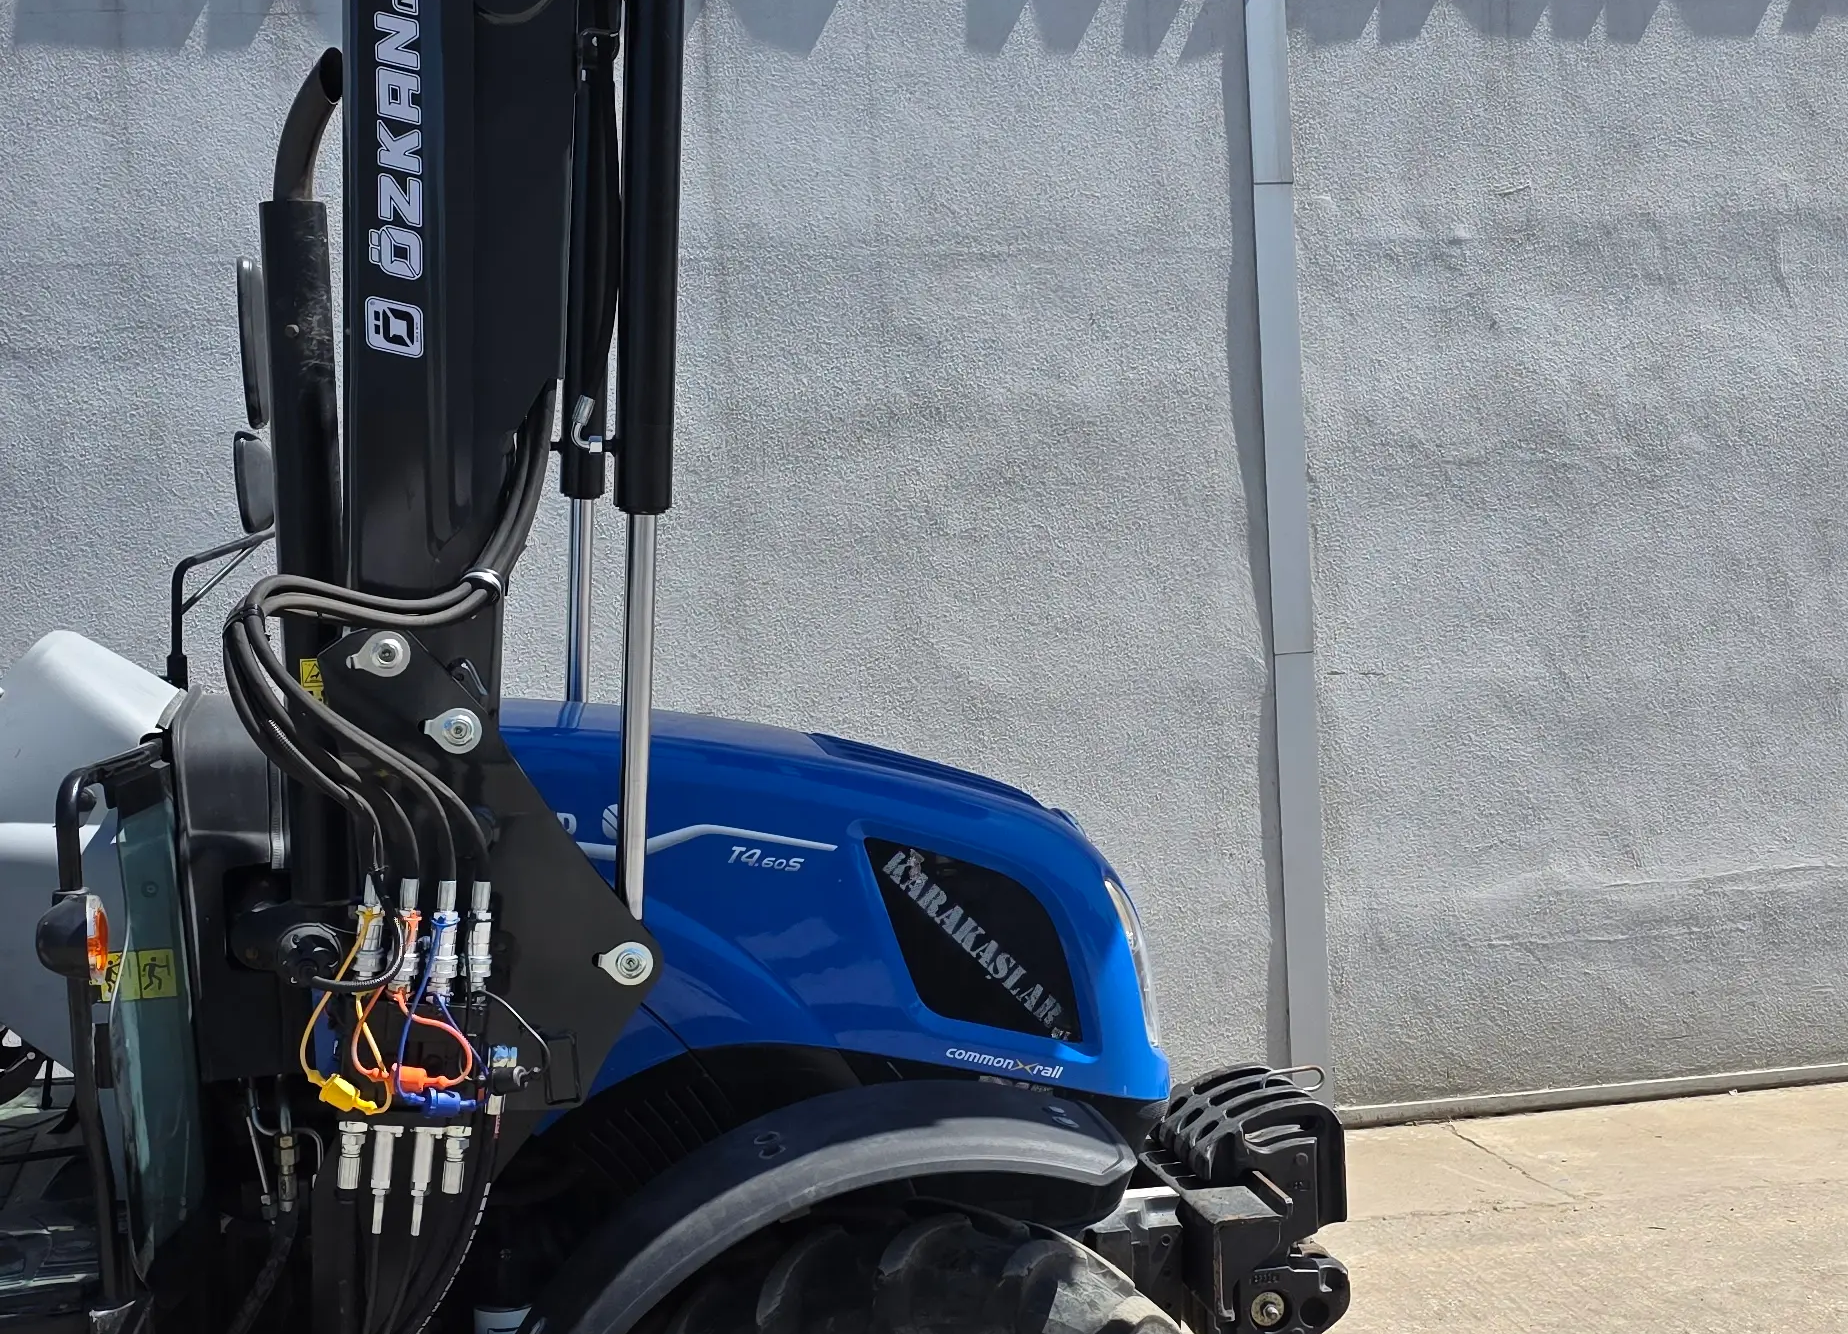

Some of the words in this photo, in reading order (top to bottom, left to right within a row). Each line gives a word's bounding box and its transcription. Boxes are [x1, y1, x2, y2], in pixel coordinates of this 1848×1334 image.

[368, 10, 423, 281] ÖZKAN
[727, 845, 805, 872] T4.60S
[882, 848, 1064, 1029] KARAKAŞLAR
[945, 1047, 1014, 1070] common
